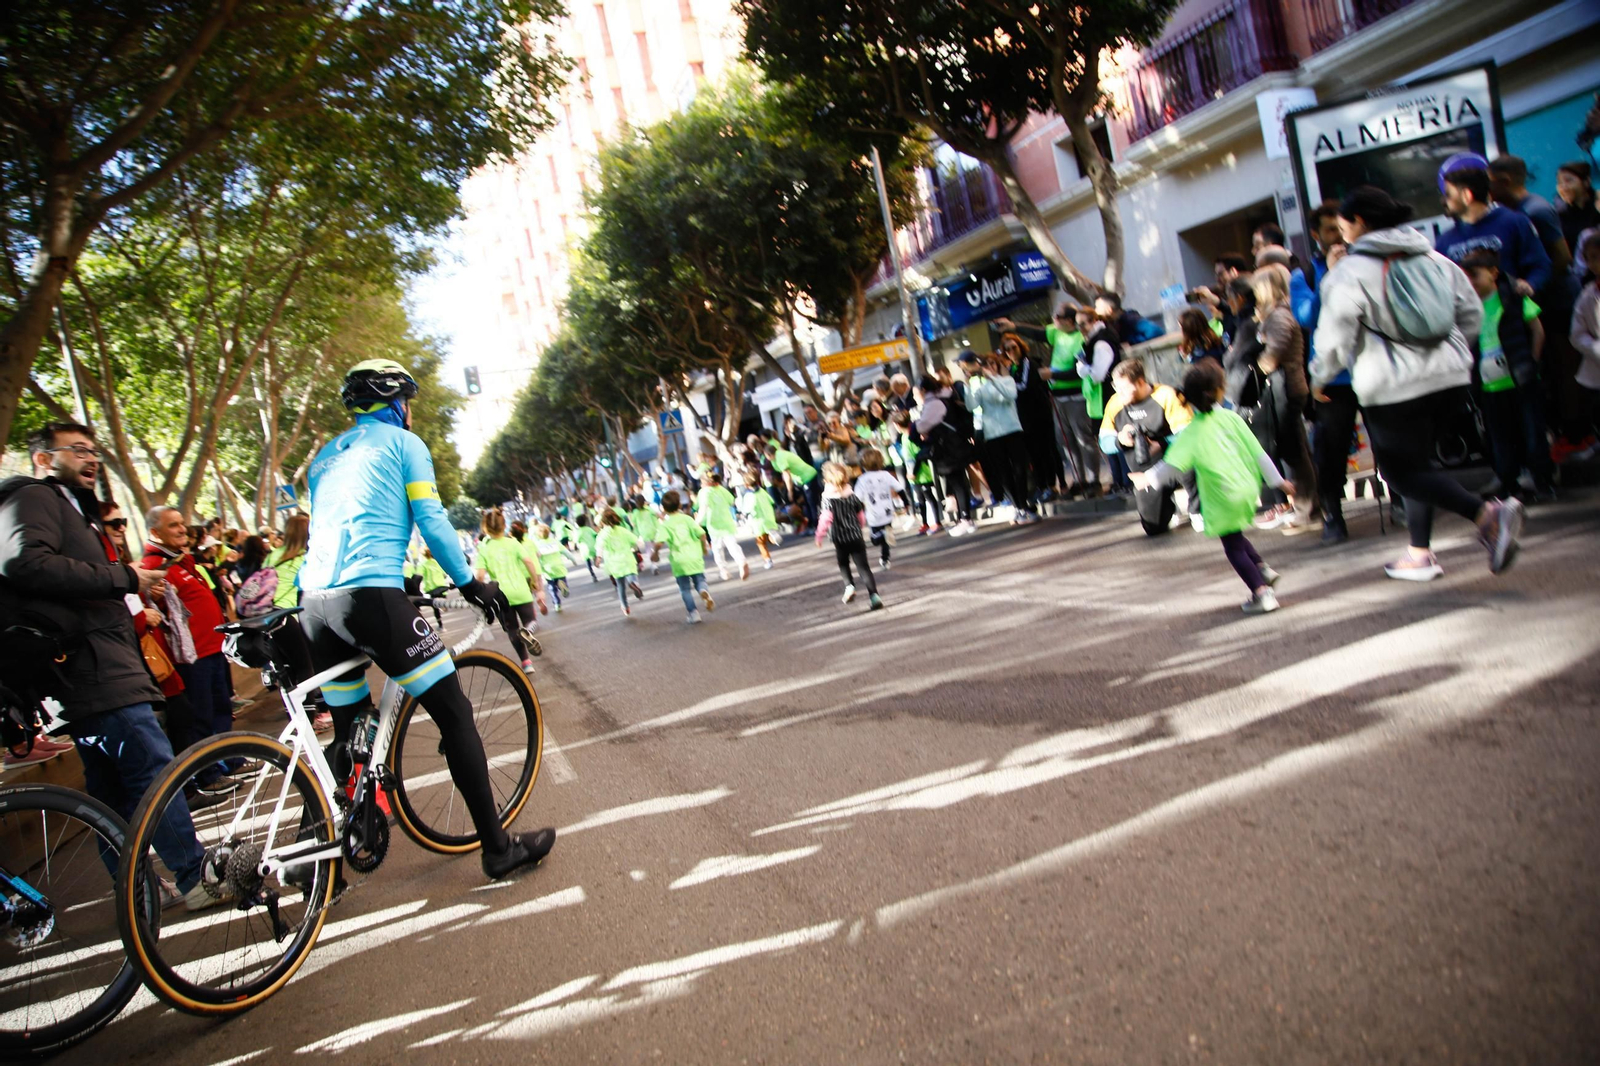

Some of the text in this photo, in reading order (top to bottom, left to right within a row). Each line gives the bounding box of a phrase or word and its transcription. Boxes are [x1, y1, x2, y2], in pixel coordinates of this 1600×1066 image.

[1314, 94, 1481, 156] ALMERÍA
[1027, 257, 1049, 270] Aura
[981, 267, 1017, 304] Aural
[406, 631, 439, 657] BIKESTO
